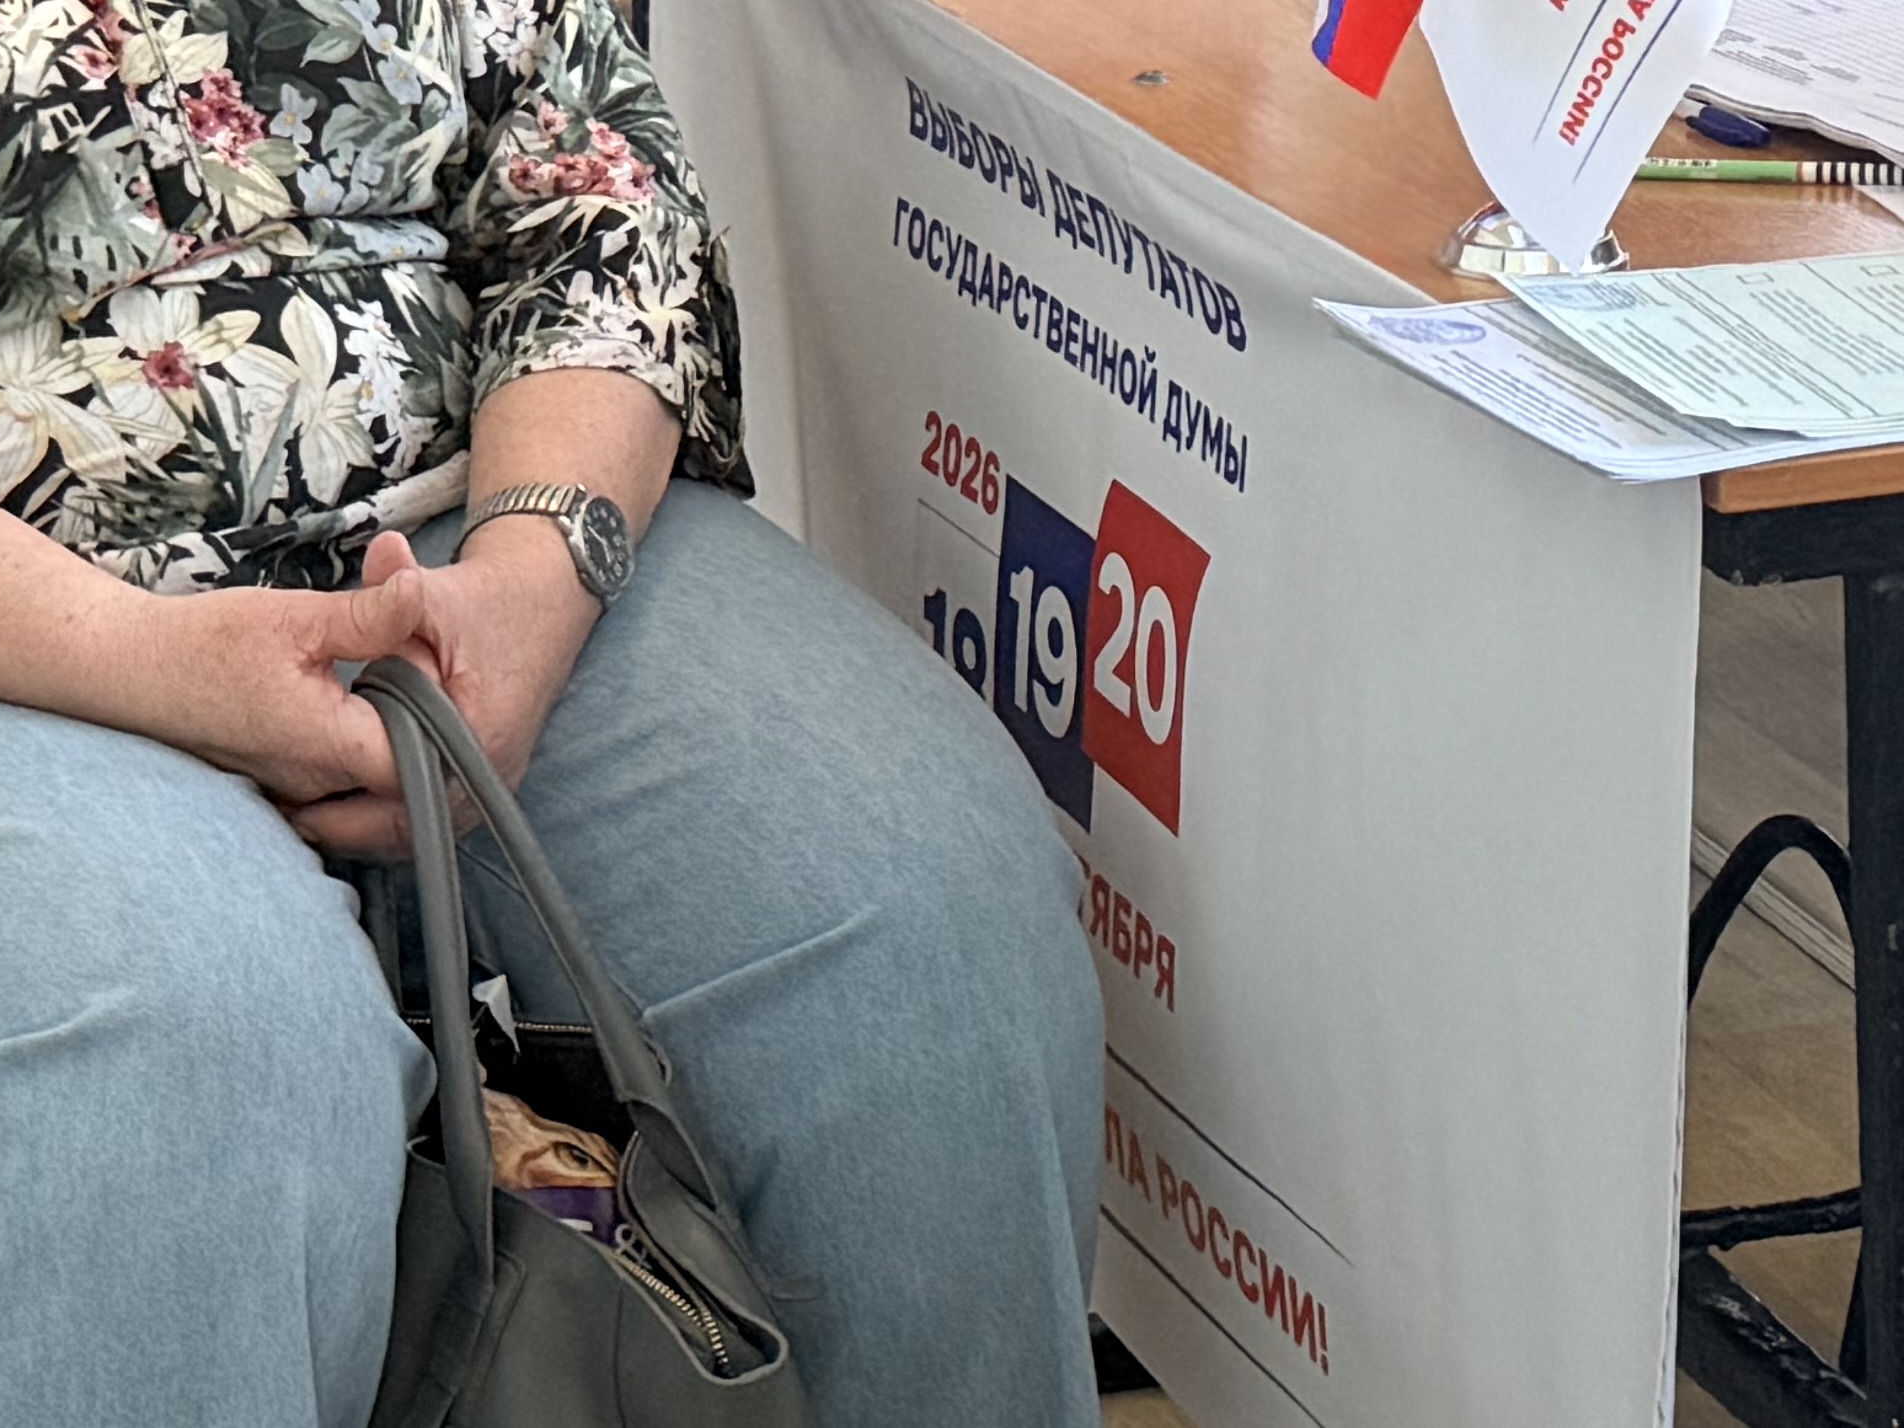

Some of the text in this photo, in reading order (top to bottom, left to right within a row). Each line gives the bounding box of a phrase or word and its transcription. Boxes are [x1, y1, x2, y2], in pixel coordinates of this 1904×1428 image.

[904, 76, 1248, 353] ВЫБОРЫ ДЕПУТАТОВ
[893, 197, 1158, 424] ГОСУДАРСТВЕННОЙ
[1162, 379, 1248, 494] ДУМЫ
[920, 410, 1001, 516] 2026
[1009, 565, 1078, 739] 19
[1094, 551, 1178, 745] 20
[1073, 850, 1176, 1013] ЯБРЯ
[1104, 1104, 1329, 1376] ЛА РОССИИ!
